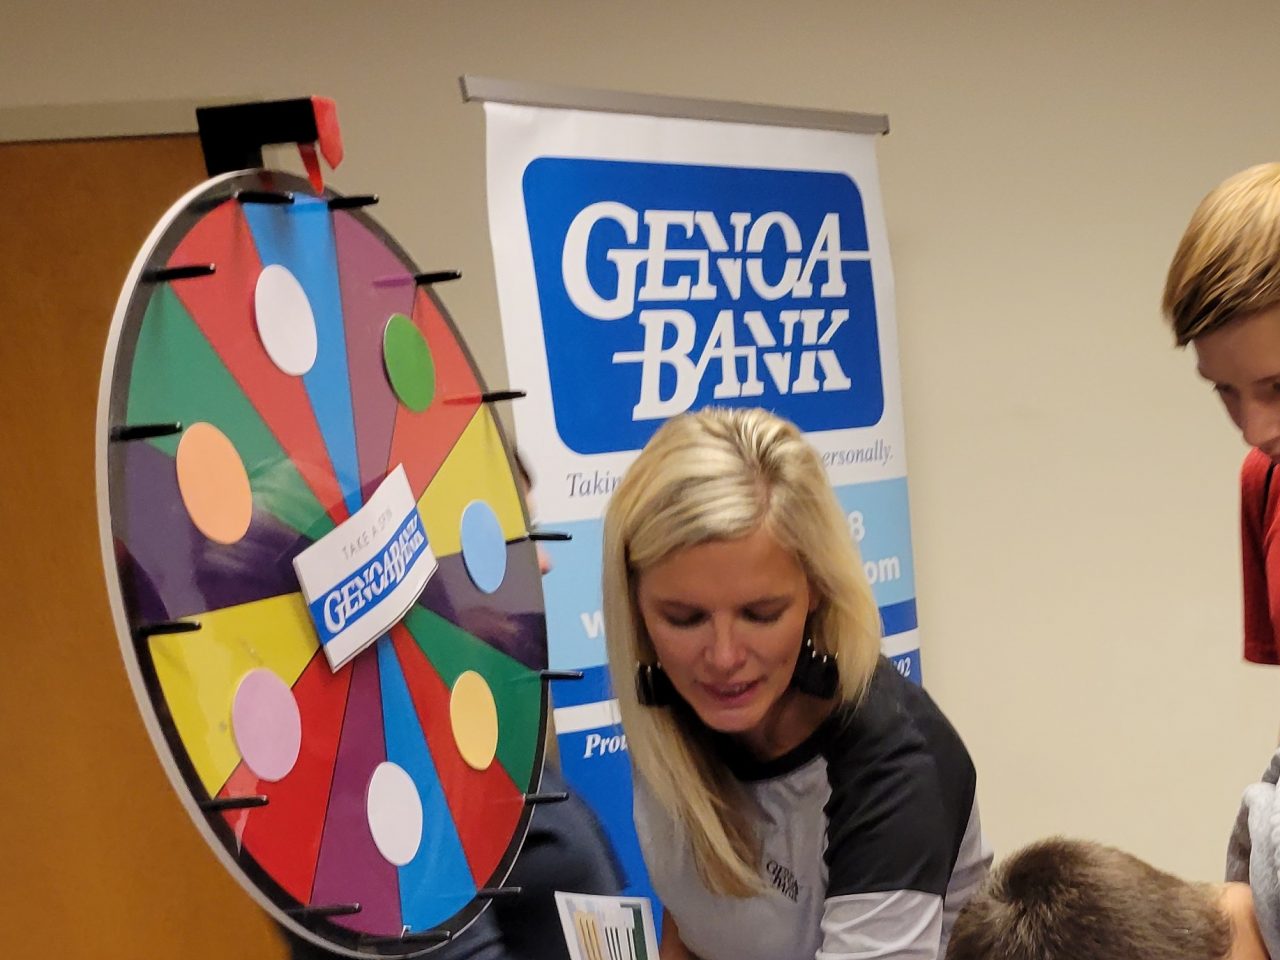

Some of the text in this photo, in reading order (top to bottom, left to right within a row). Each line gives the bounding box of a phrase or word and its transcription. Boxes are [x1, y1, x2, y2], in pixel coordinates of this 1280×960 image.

[562, 201, 871, 320] GENOA
[612, 309, 851, 420] BANK
[822, 438, 894, 467] ersonally.
